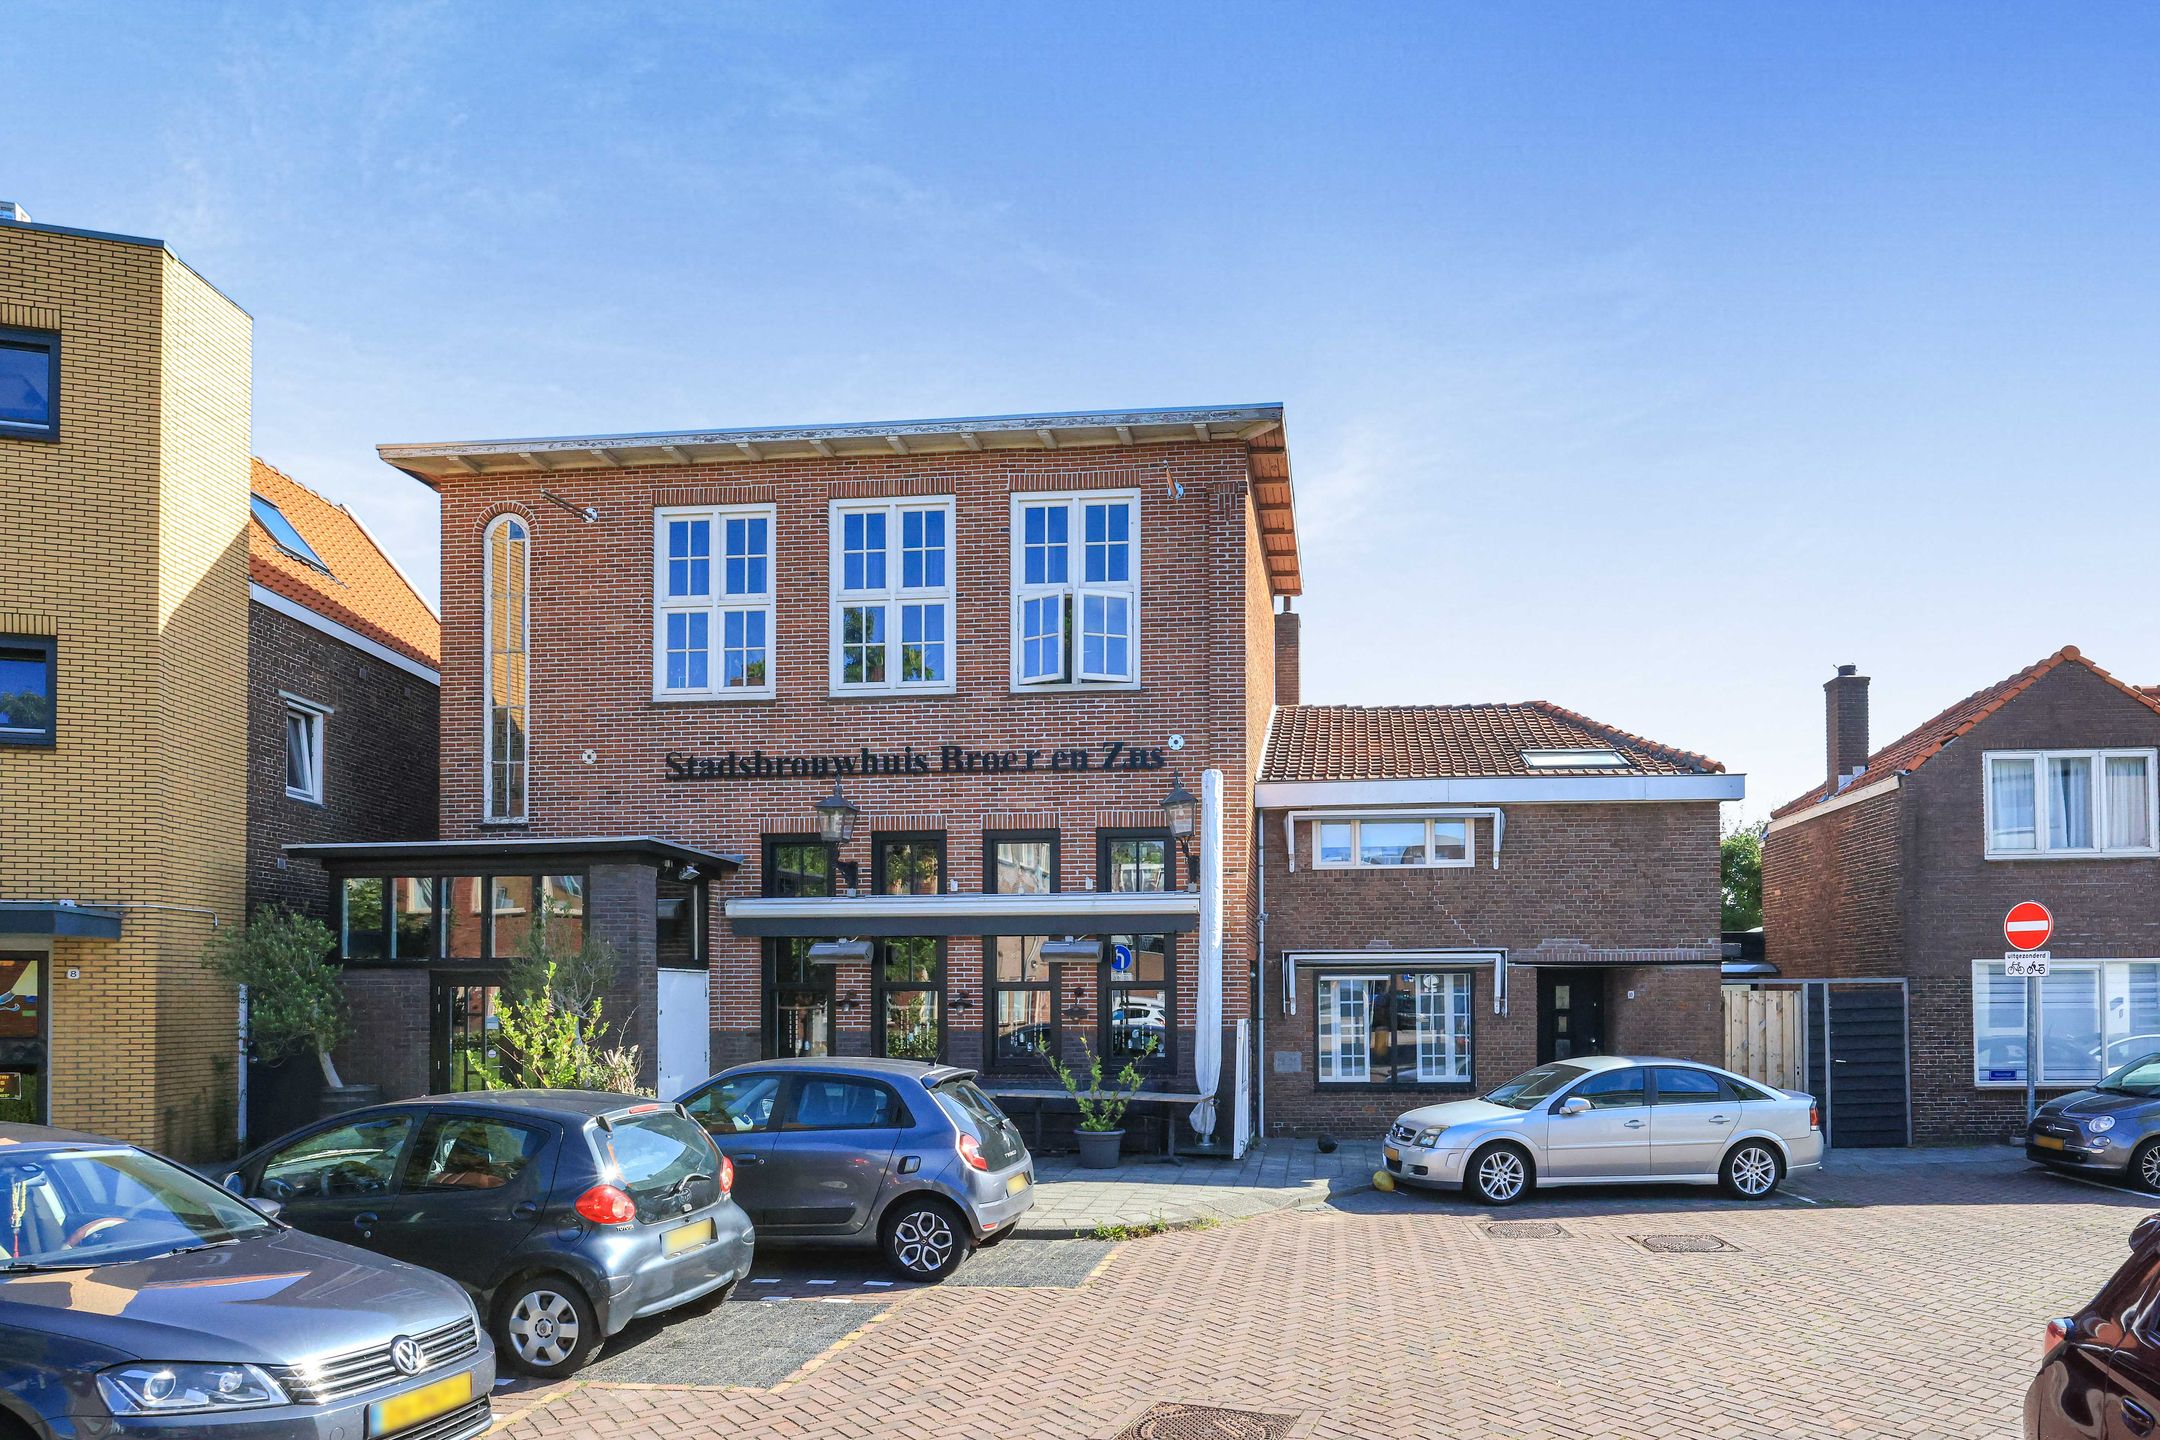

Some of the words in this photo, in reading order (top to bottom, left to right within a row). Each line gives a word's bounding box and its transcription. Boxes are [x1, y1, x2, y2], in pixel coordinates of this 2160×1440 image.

[666, 747, 928, 780] Stadsbrouwhuis
[939, 746, 1041, 773] Broer
[1052, 748, 1088, 771] en
[1103, 742, 1167, 771] Zus
[2007, 952, 2046, 960] uitgezonderd
